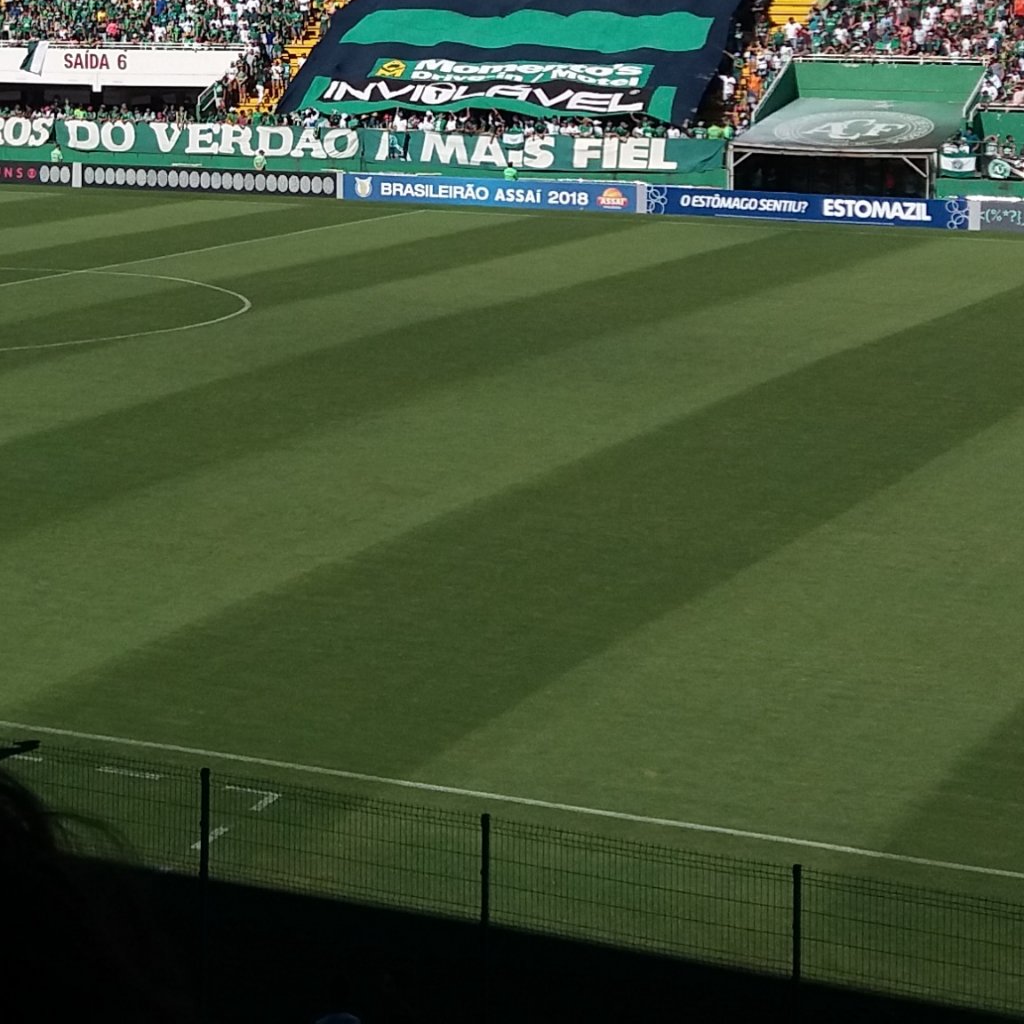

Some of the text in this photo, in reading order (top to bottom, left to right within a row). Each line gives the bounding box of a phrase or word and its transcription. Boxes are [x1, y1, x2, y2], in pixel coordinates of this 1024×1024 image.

[64, 50, 127, 70] SAÍDA 6
[550, 69, 639, 86] Motel
[65, 120, 135, 152] DO
[572, 136, 678, 170] FIEL
[381, 182, 489, 201] BRASILEIRÃO
[548, 190, 588, 206] 2018
[680, 194, 809, 213] O ESTÔMAGO SENTIU?
[823, 198, 932, 222] ESTOMAZIL
